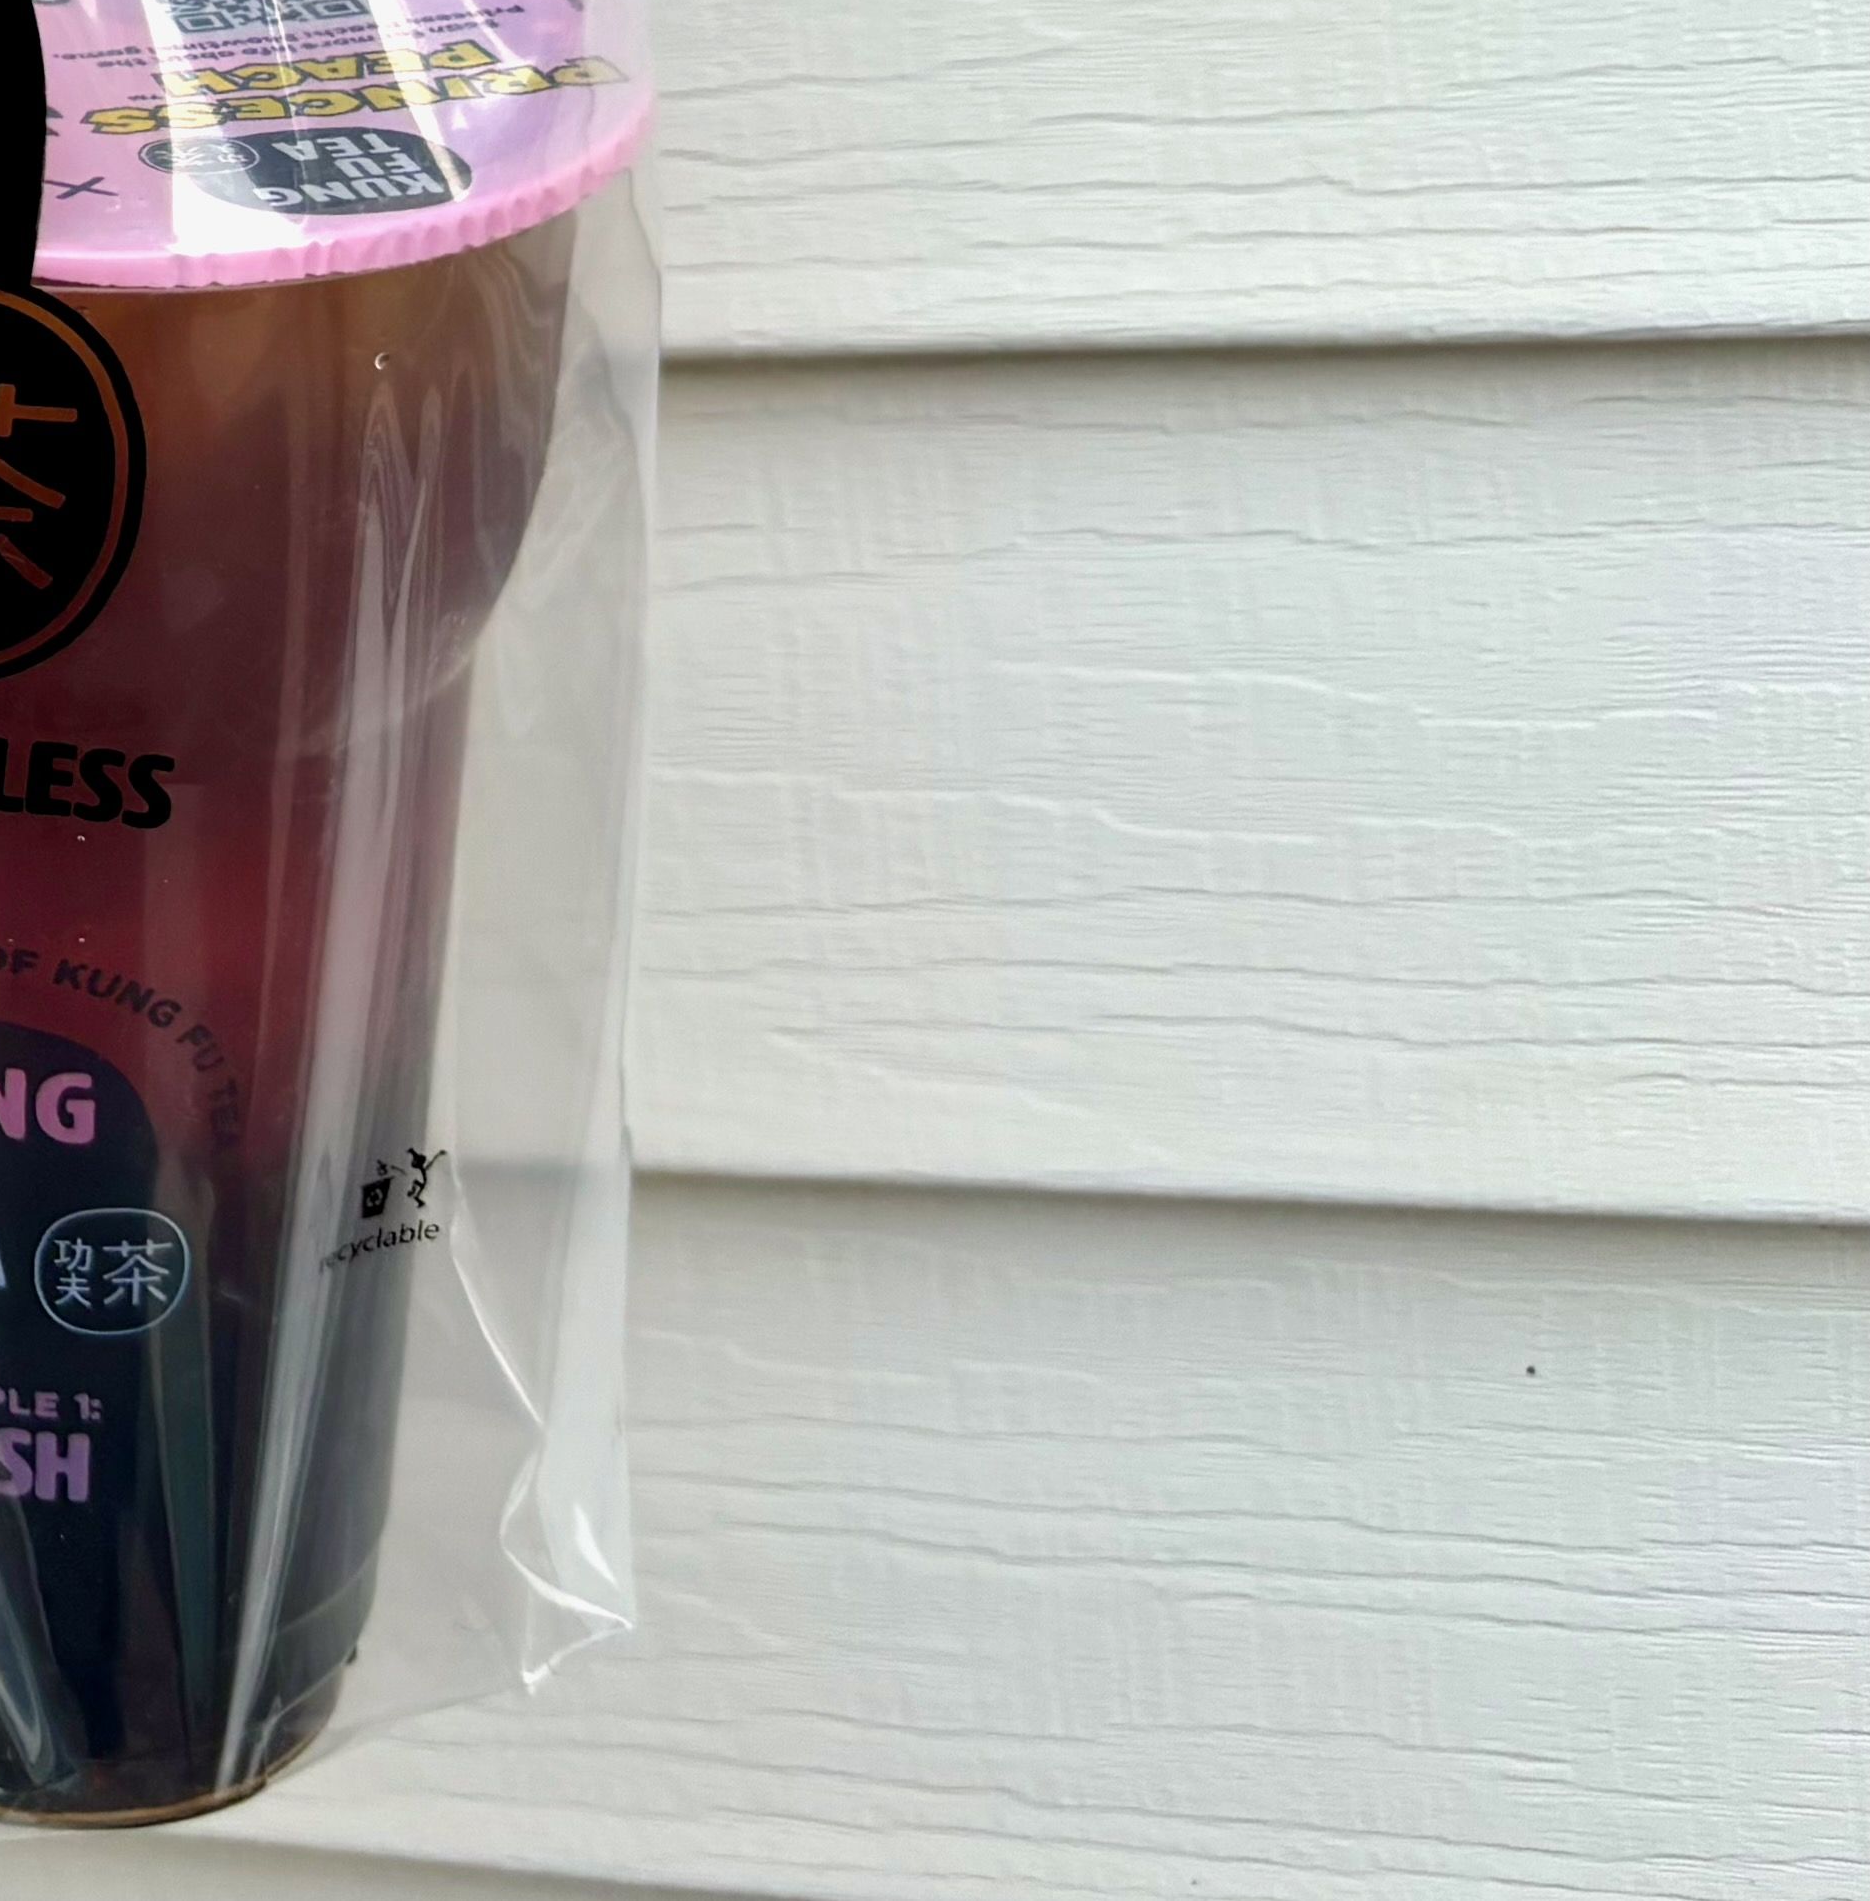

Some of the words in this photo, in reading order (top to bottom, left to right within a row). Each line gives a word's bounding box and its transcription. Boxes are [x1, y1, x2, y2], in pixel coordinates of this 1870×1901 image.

[153, 39, 501, 98] PEACH
[81, 55, 629, 135] PRINCESS
[271, 133, 401, 162] TEA
[333, 152, 419, 179] FU
[252, 171, 445, 206] KUNG
[53, 958, 182, 1030] KUNG
[176, 1023, 228, 1076] FU
